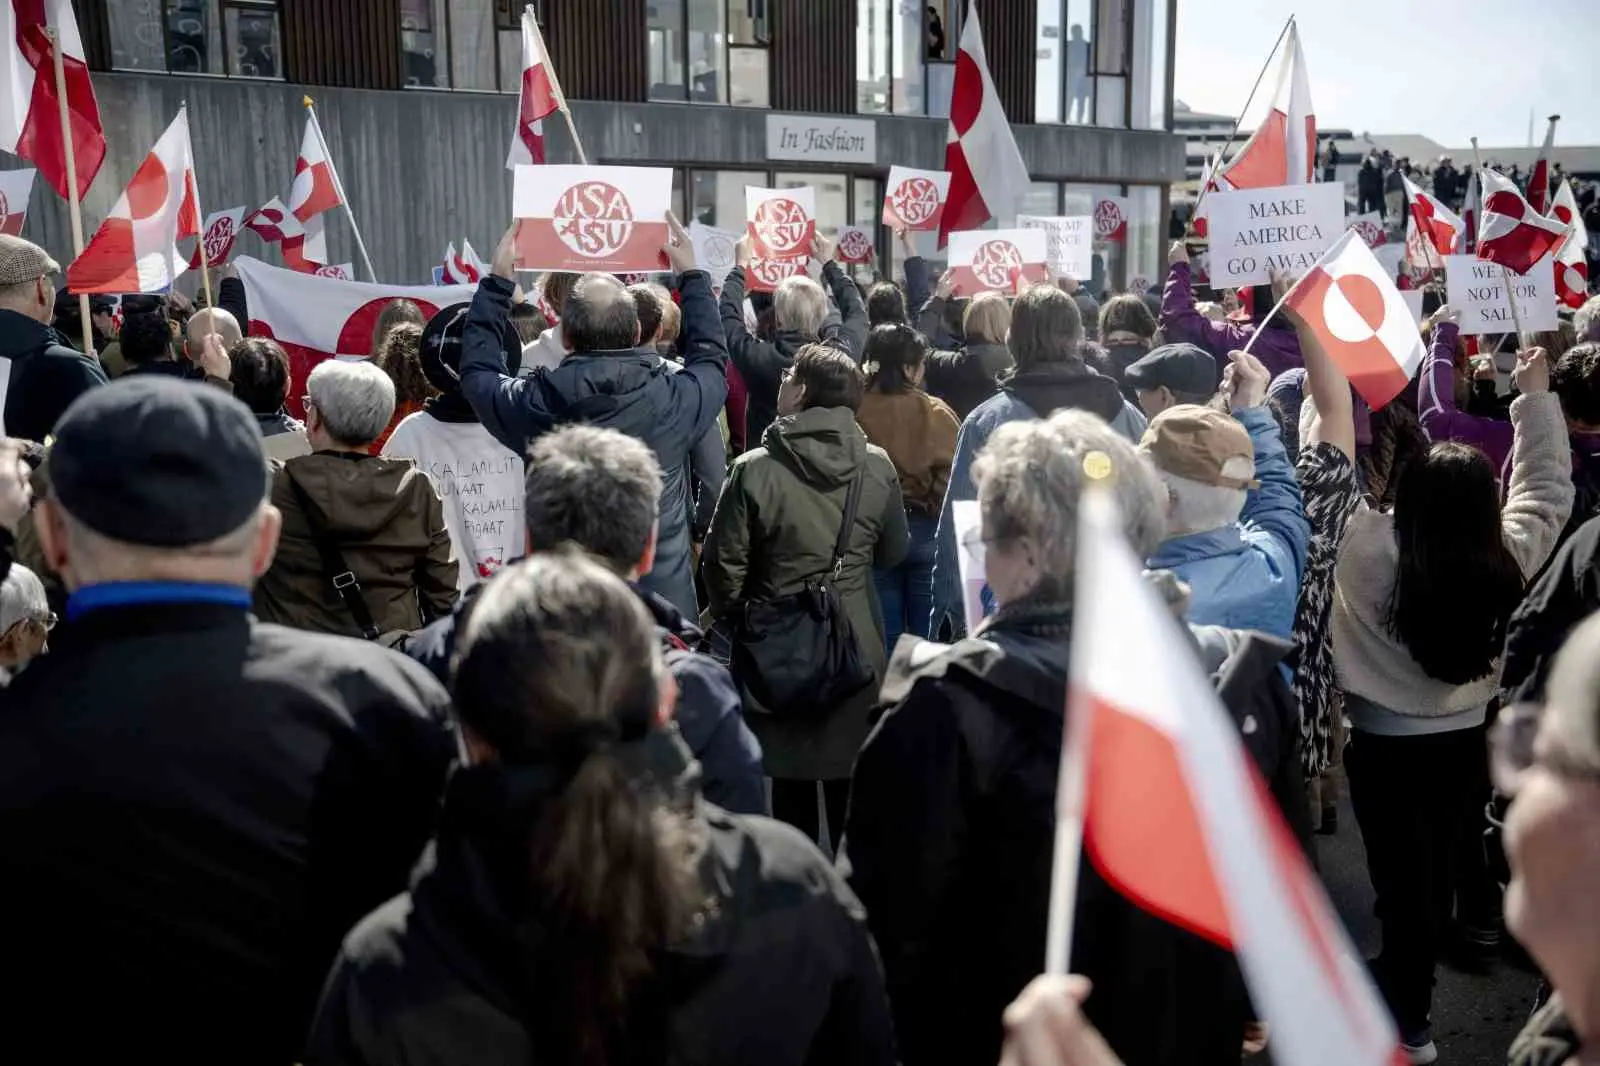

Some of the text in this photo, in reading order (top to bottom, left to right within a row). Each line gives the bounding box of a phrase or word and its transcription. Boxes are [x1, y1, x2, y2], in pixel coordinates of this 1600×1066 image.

[779, 125, 865, 153] In Fashion
[561, 183, 630, 220] USA
[1248, 199, 1306, 220] MAKE
[1234, 224, 1322, 247] AMERICA
[1227, 251, 1325, 275] GO AWAY
[1472, 264, 1496, 279] WE
[1467, 284, 1537, 301] NOT OR
